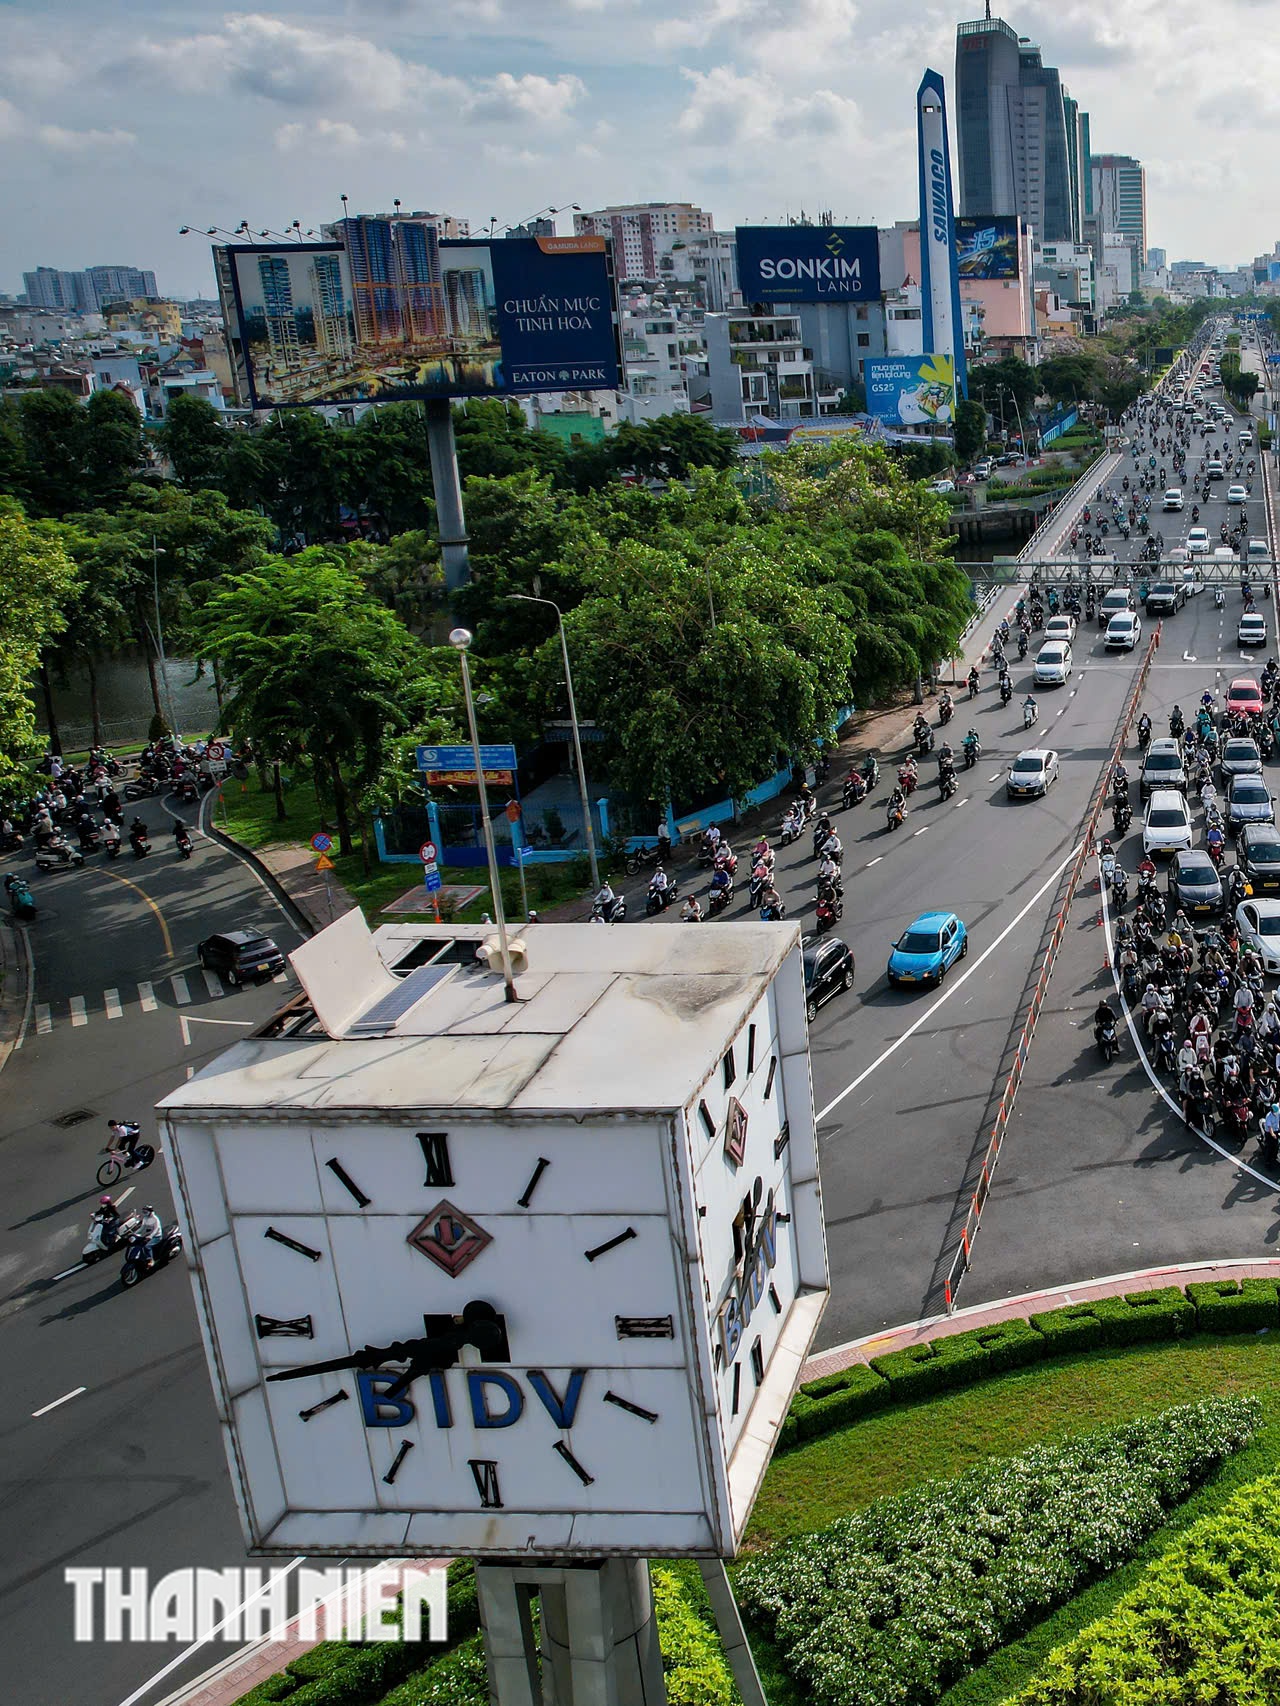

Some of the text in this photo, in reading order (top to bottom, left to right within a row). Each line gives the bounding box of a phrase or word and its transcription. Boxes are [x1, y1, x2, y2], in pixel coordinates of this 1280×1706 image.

[930, 148, 948, 246] SAWACO
[759, 257, 861, 279] SONKIM
[817, 280, 862, 292] LAND
[504, 294, 601, 314] CHUẨN MỰC
[516, 316, 592, 332] TINH HOA
[512, 368, 606, 383] EATON PARK
[871, 383, 895, 392] GS25
[355, 1367, 588, 1430] BIDV
